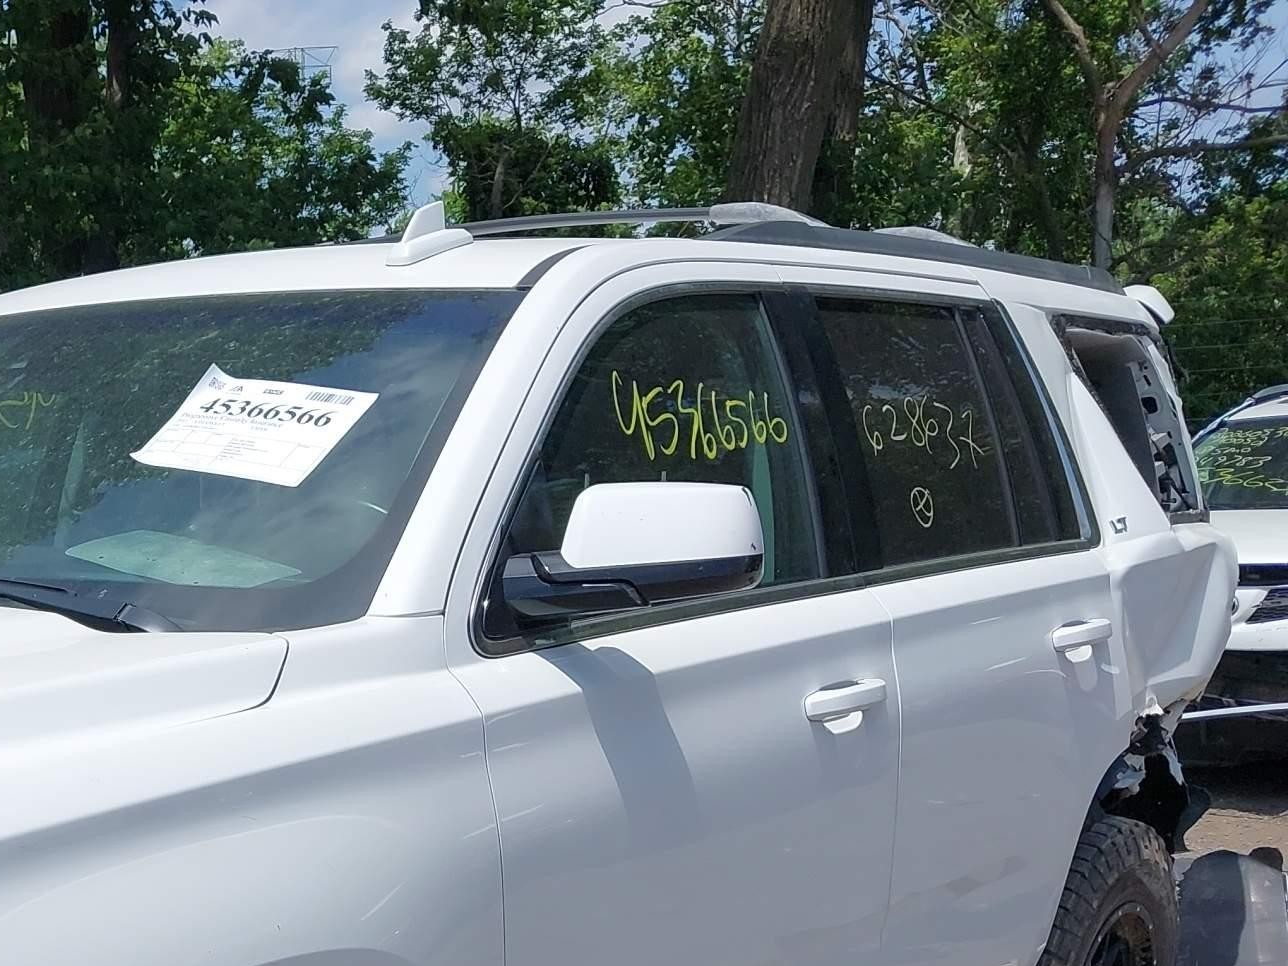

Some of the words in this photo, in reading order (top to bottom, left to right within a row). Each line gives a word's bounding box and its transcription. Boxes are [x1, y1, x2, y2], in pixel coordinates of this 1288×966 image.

[199, 397, 335, 428] 45366566
[613, 370, 788, 461] 45366566
[863, 395, 985, 469] 628637
[1109, 517, 1128, 534] LT
